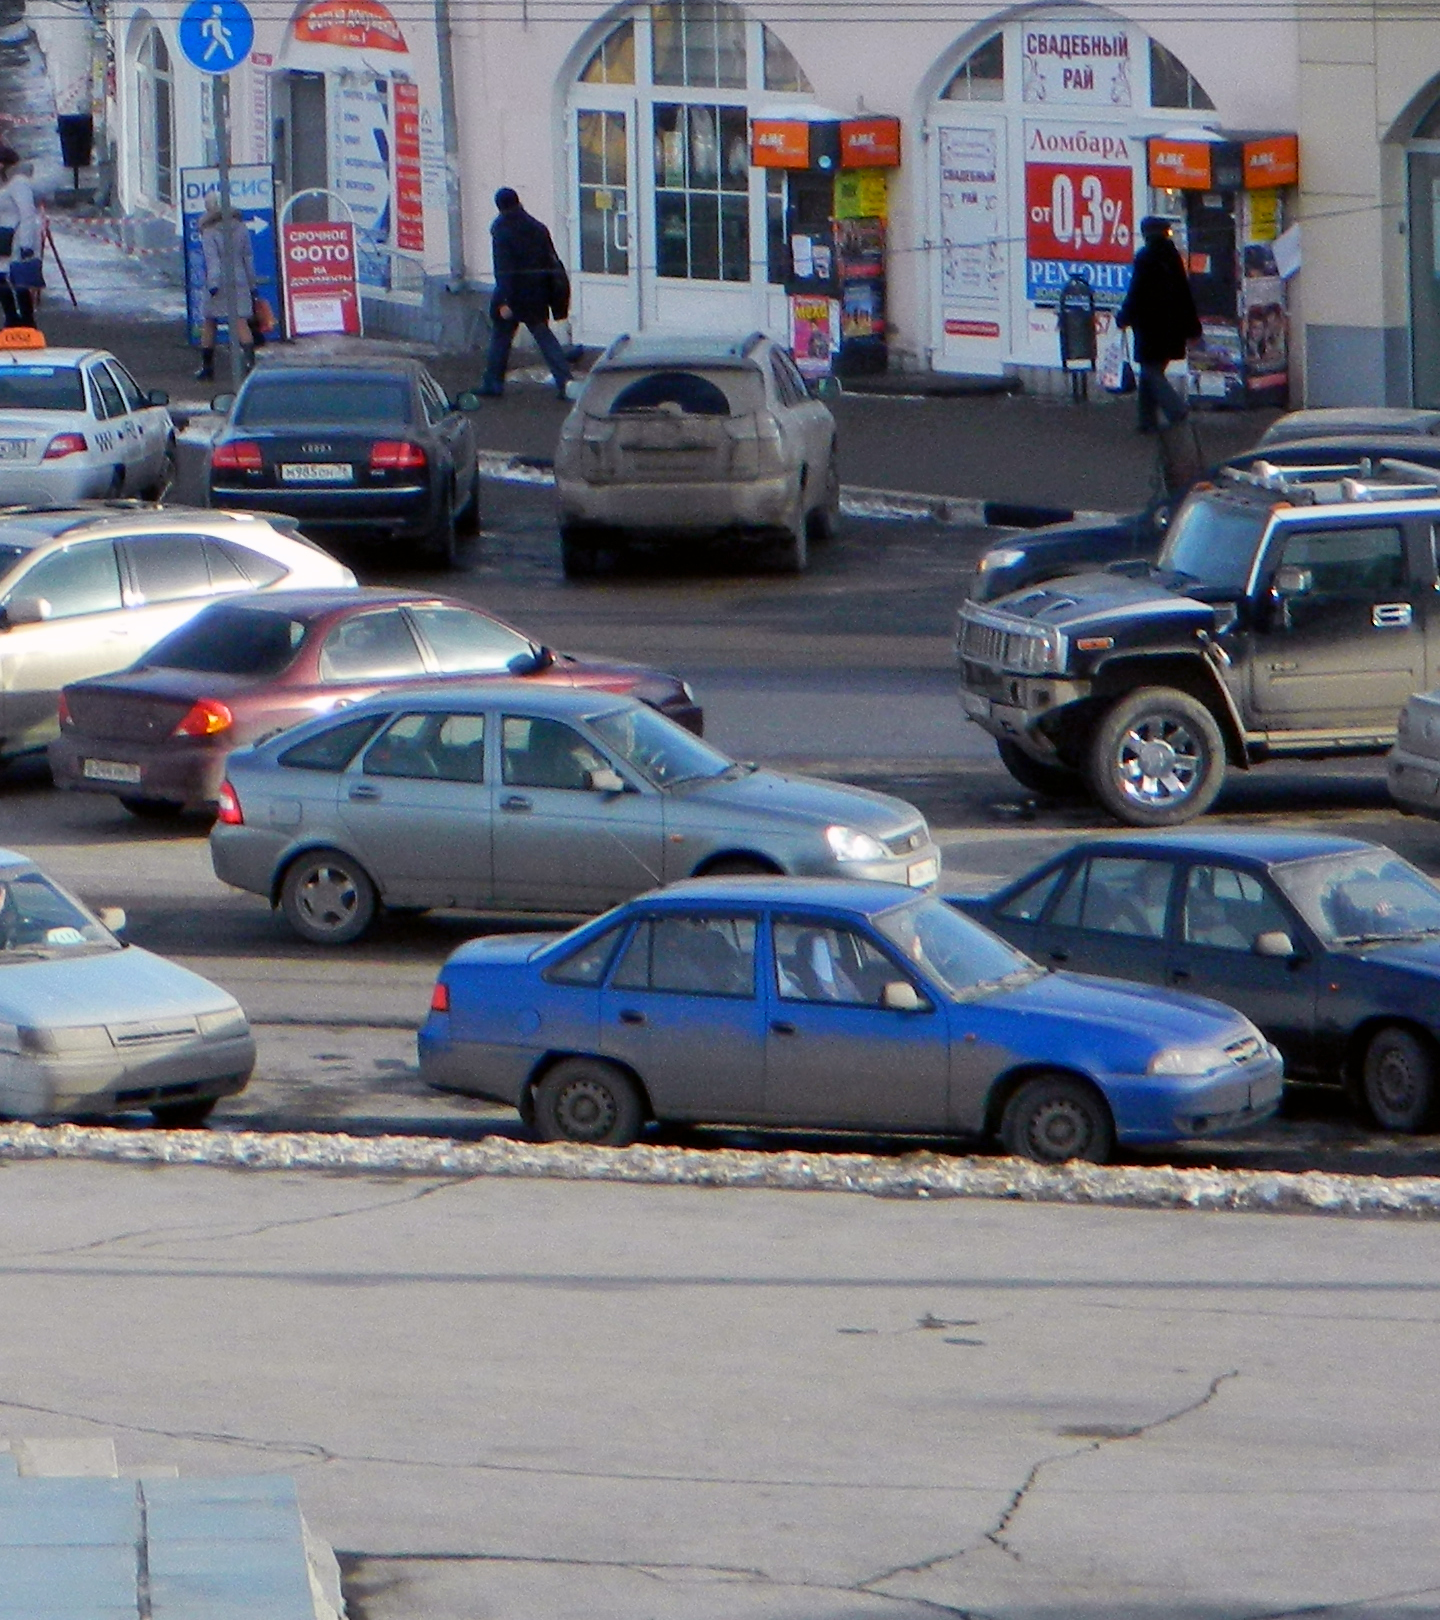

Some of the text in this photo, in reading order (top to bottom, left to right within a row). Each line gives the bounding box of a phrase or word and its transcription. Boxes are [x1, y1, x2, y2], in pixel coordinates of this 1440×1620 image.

[1026, 31, 1129, 59] СВАДЕБНЫЙ
[1062, 66, 1095, 91] РАЙ
[1030, 127, 1129, 160] Ломбард
[1031, 206, 1052, 223] от
[289, 230, 348, 242] СРОЧНОЕ
[290, 244, 350, 262] ФОТО
